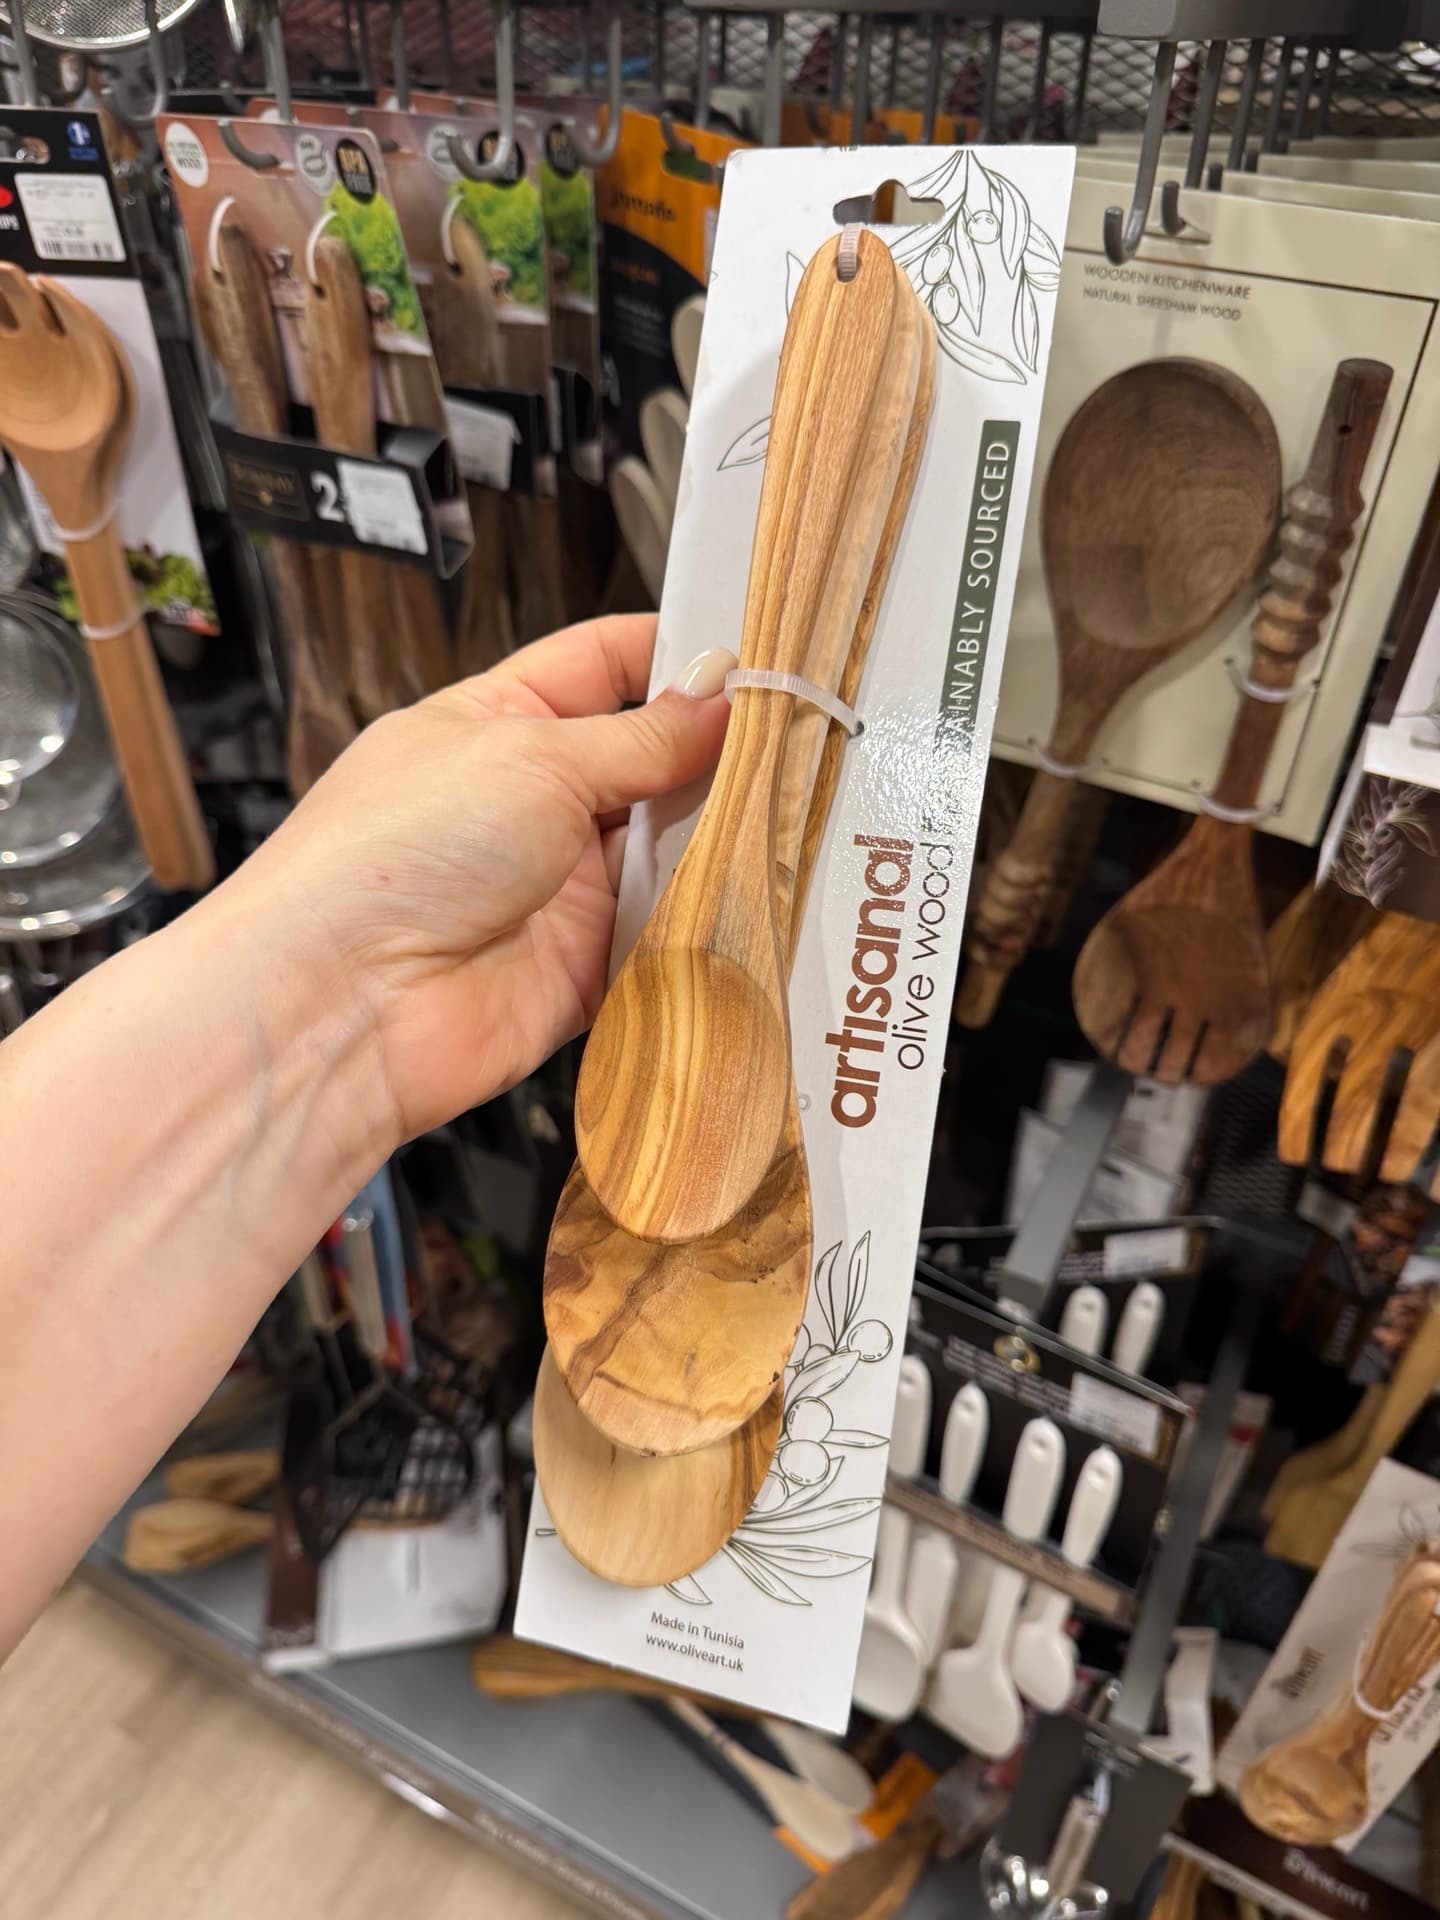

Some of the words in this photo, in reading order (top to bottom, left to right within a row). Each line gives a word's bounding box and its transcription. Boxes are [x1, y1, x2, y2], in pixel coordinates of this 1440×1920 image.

[1082, 287, 1132, 306] NATURAL
[1200, 305, 1242, 321] WOOD
[1084, 264, 1149, 284] WOODEN
[1152, 273, 1252, 299] KITCHENWARE
[967, 440, 1010, 589] SOURCED
[912, 842, 954, 961] wood
[825, 834, 915, 1129] artisanal
[891, 973, 935, 1070] olive
[646, 1633, 744, 1672] www.oliveart.uk
[650, 1610, 685, 1632] Made
[687, 1621, 700, 1636] in
[702, 1625, 745, 1649] Tunisia
